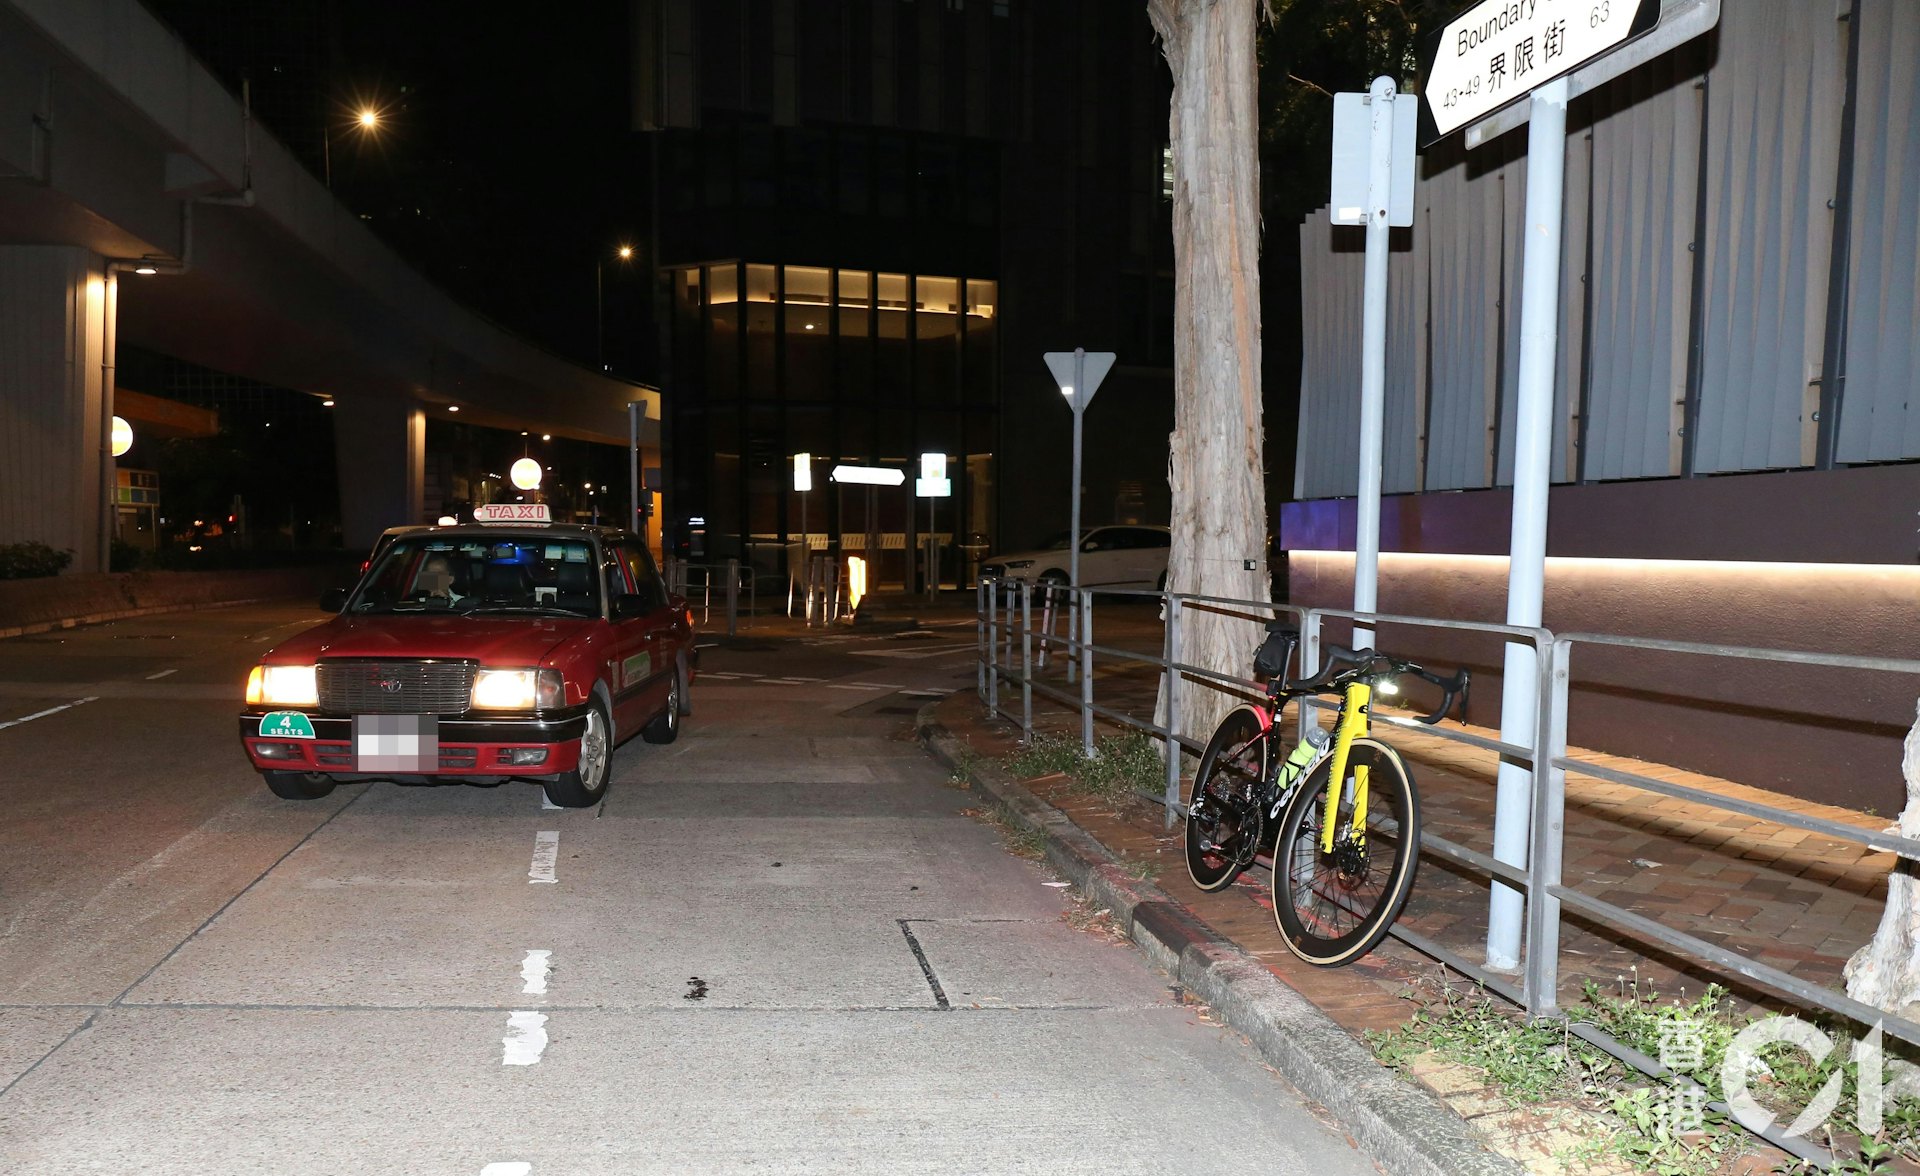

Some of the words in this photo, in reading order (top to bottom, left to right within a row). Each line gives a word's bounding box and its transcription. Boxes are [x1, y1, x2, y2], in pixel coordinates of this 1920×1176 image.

[1457, 0, 1536, 58] Boundary
[1487, 18, 1566, 93] 界限街
[1589, 0, 1610, 29] 63
[486, 505, 544, 519] TAXI
[280, 715, 291, 728] 4
[270, 728, 303, 736] SEATS
